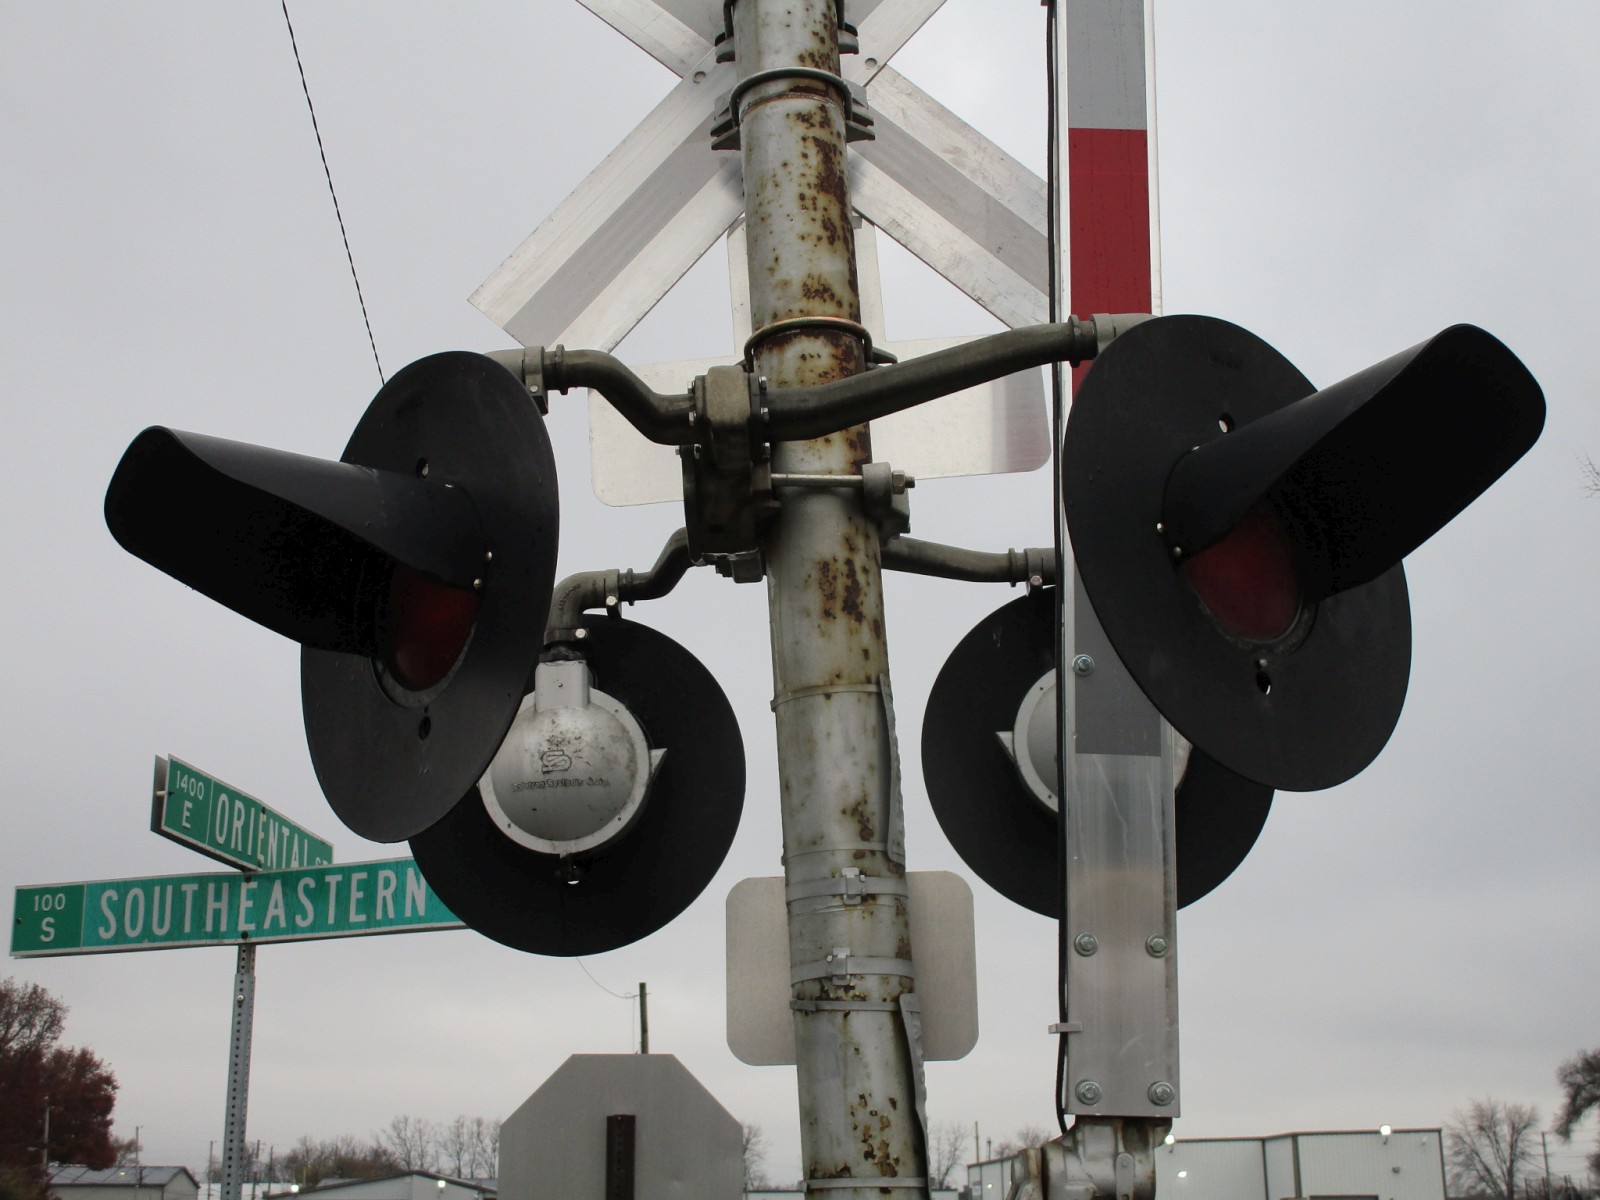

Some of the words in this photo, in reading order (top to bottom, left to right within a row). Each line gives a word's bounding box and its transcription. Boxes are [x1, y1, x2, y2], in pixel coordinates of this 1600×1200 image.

[176, 770, 205, 800] 1400
[182, 800, 193, 828] E
[215, 793, 308, 869] ORIENTAL
[33, 893, 66, 912] 100
[98, 868, 427, 939] SOUTHEASTERN
[39, 917, 55, 942] S
